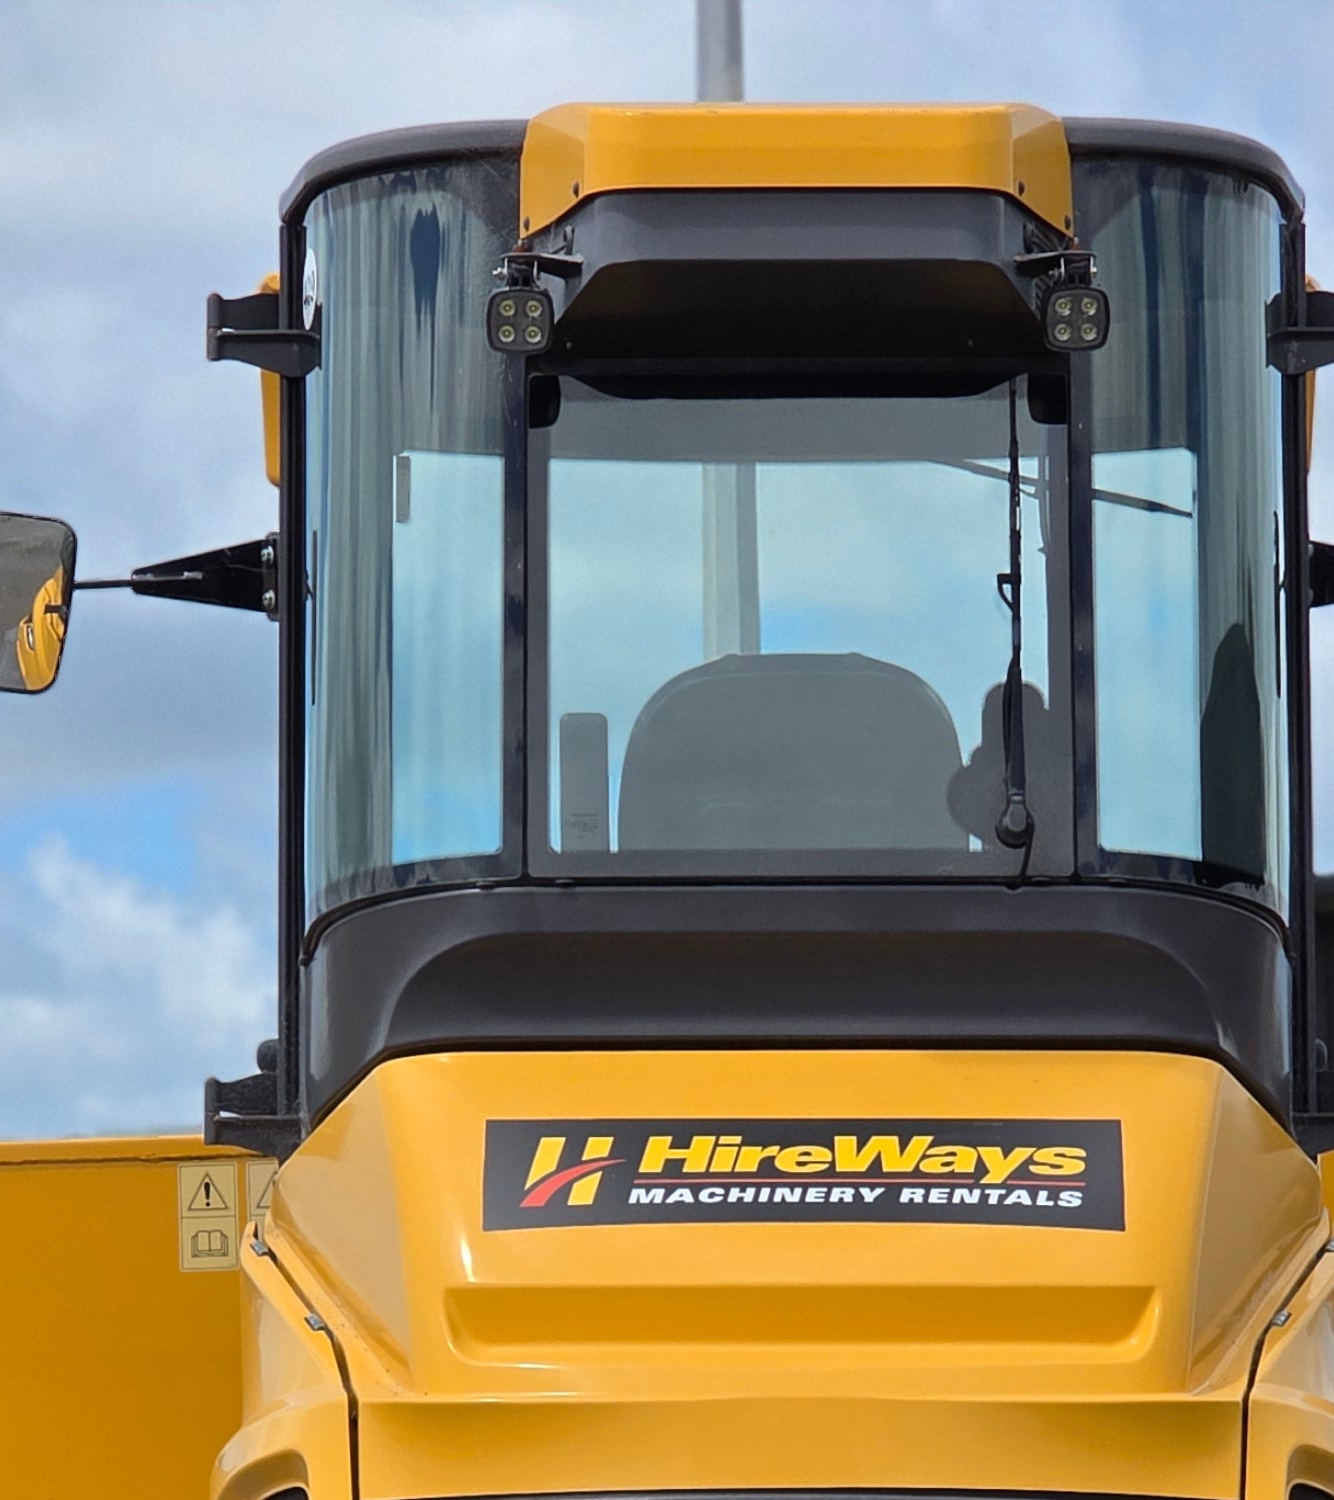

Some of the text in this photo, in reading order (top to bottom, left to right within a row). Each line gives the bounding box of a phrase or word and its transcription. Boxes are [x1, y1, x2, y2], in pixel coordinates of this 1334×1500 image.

[635, 1134, 1087, 1184] HireWays
[628, 1185, 1084, 1208] MACHINERY RENTALS
